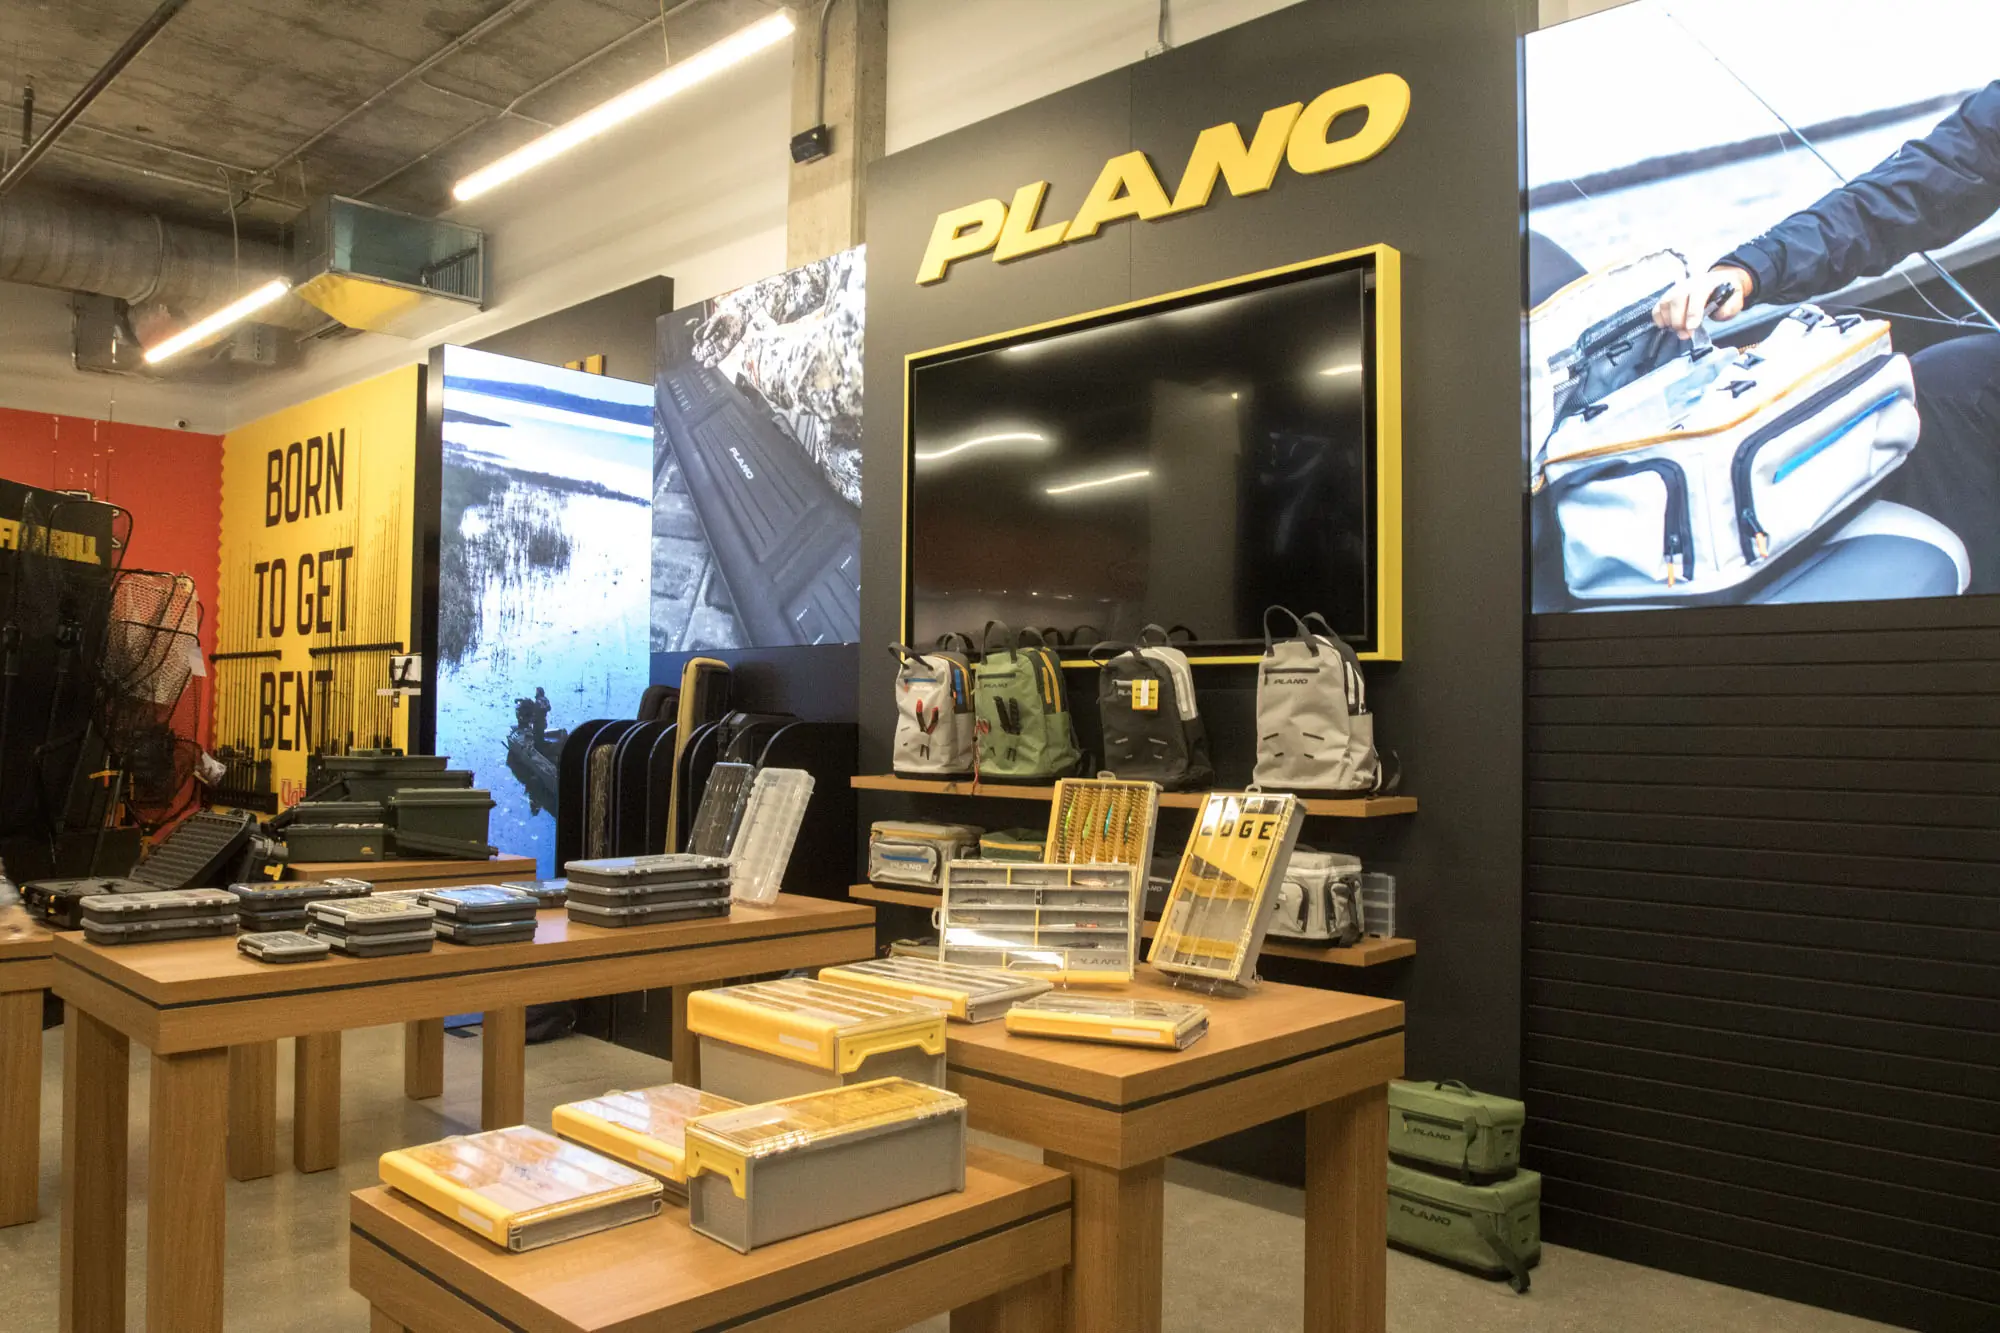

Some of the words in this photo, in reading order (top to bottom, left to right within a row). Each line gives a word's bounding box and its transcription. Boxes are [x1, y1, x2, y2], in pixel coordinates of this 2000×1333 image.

[915, 73, 1412, 285] PLANO
[265, 428, 346, 528] BORN
[729, 447, 754, 479] PLANO
[254, 557, 287, 639] TO
[297, 546, 354, 635] GET
[259, 669, 333, 752] BENT
[1201, 819, 1276, 840] DGE
[1413, 1128, 1451, 1140] PLANO
[1400, 1204, 1451, 1226] PLANO
